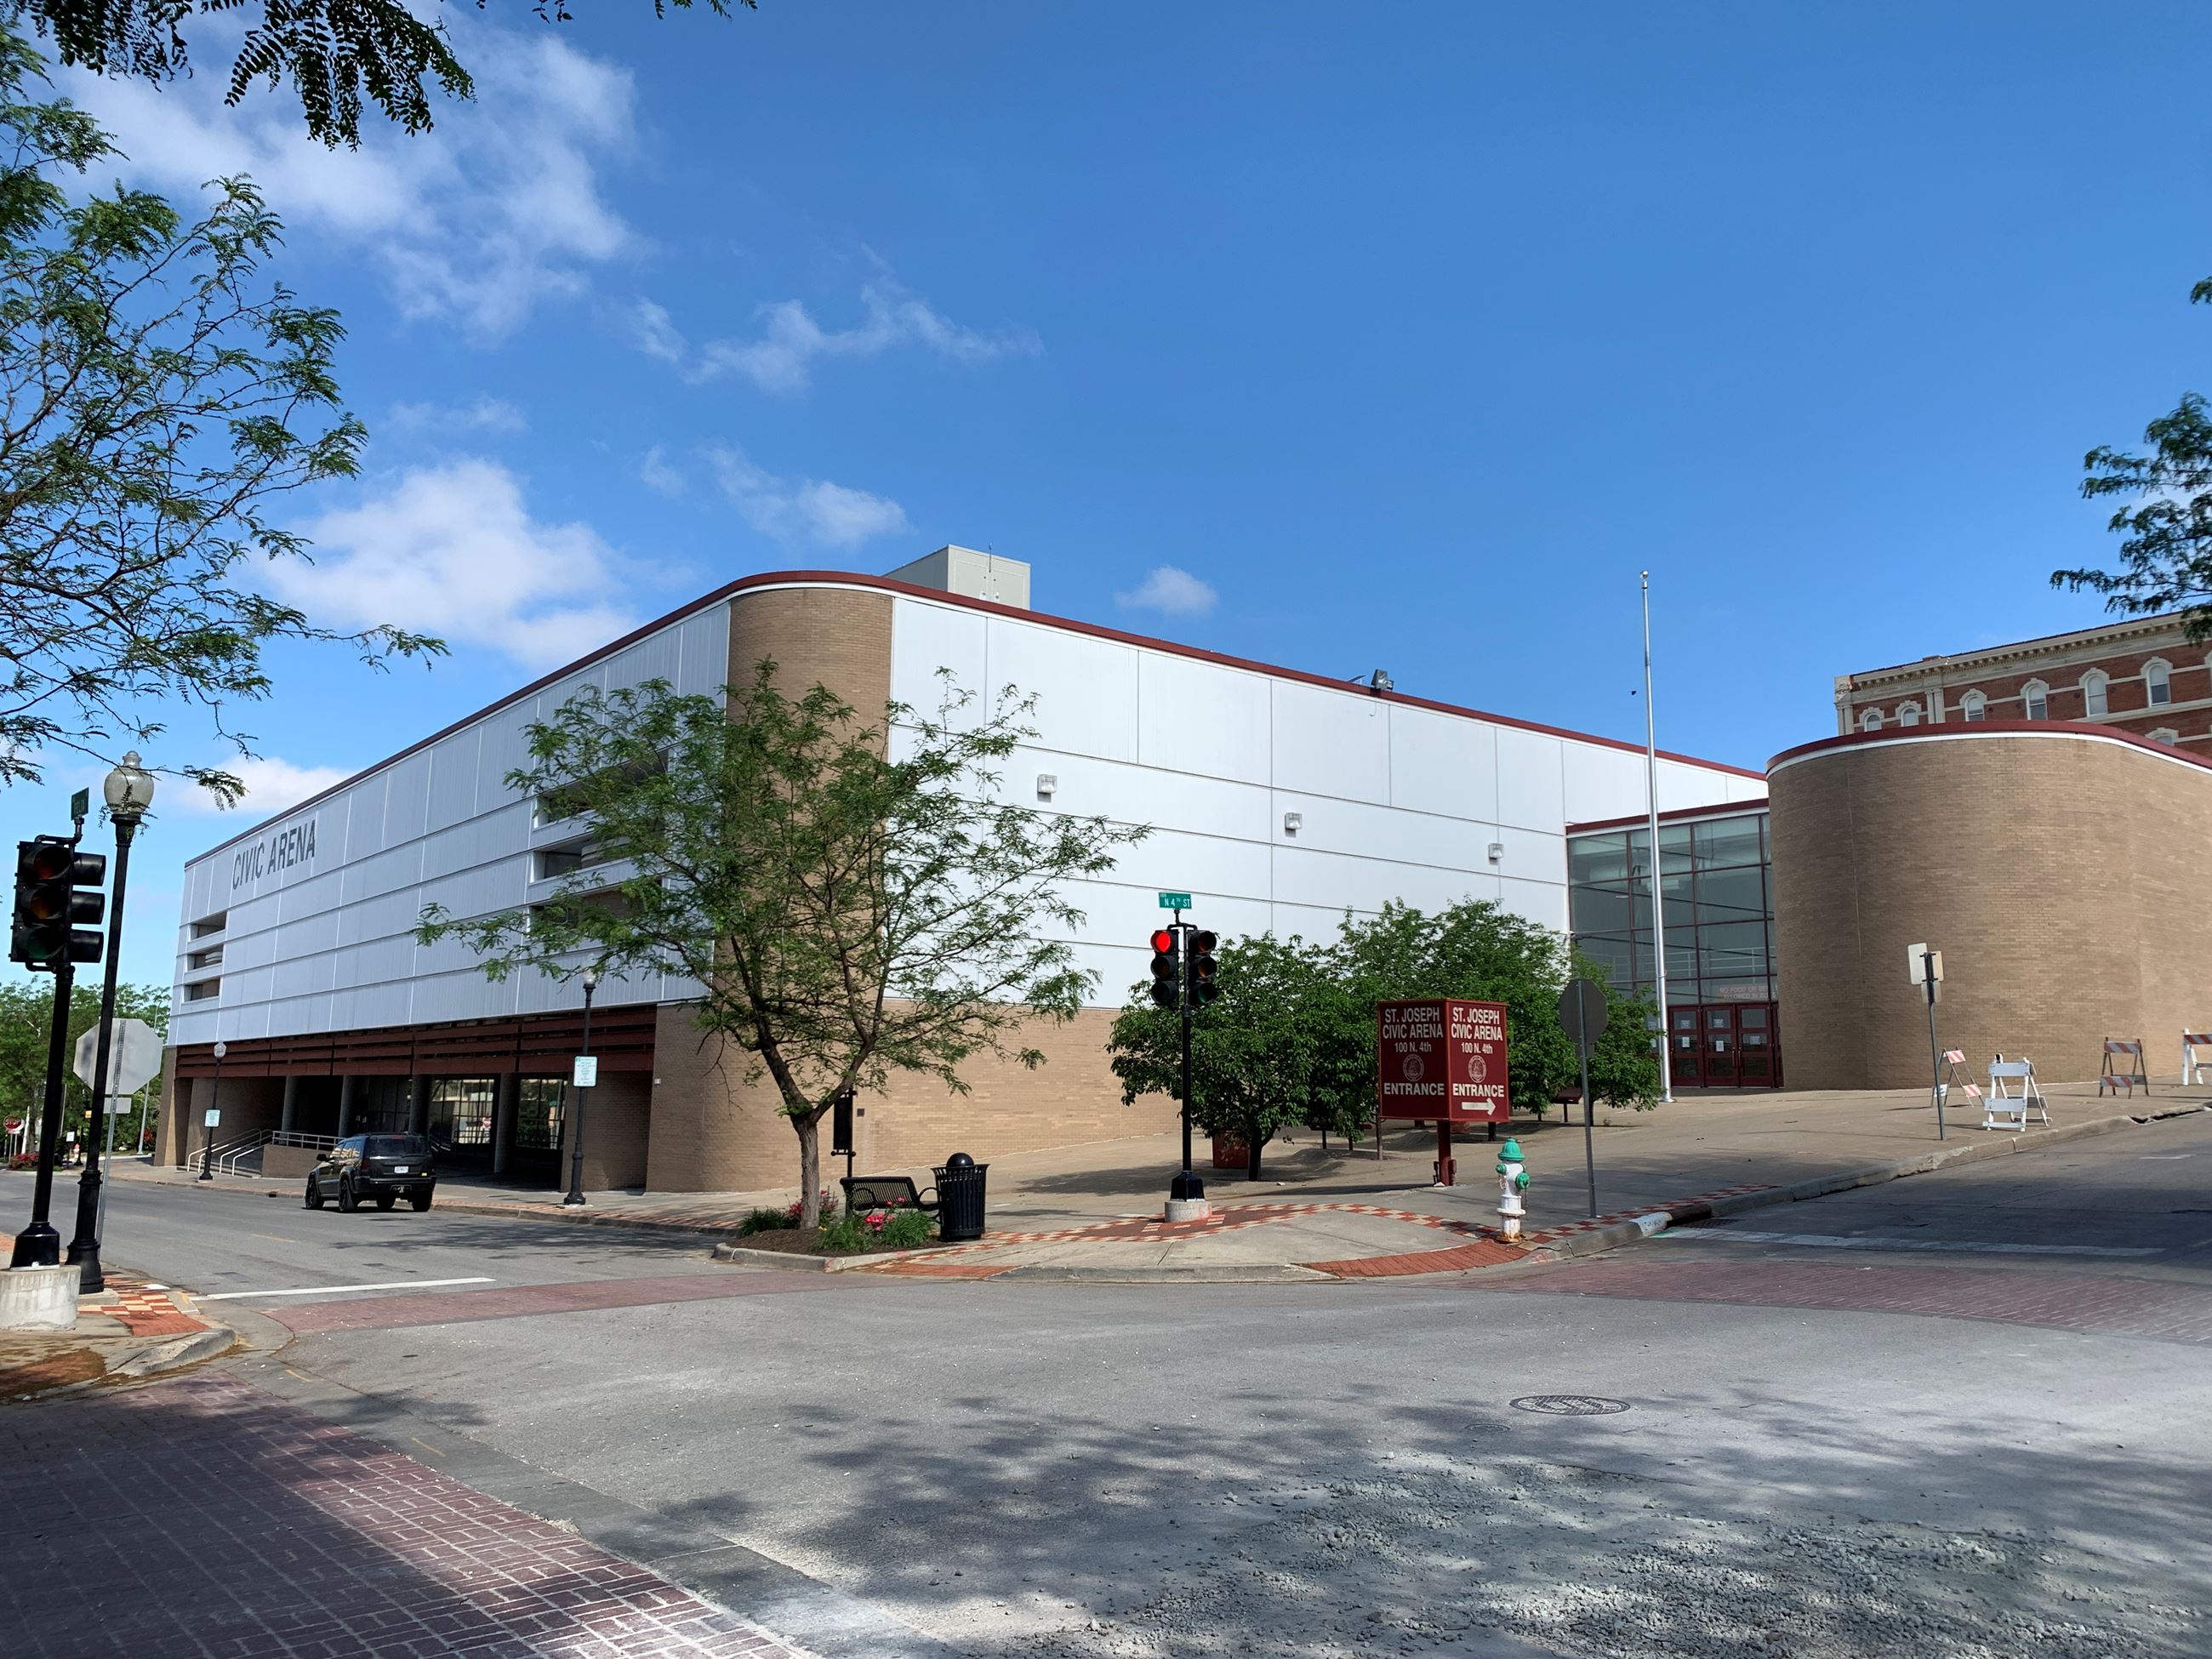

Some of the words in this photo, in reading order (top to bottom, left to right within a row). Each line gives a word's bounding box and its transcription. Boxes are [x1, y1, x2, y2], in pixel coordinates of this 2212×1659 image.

[232, 842, 265, 890] CIVIC
[267, 819, 316, 875] ARENA
[1164, 898, 1169, 906] N
[1183, 898, 1190, 907] ST
[1385, 1008, 1400, 1023] ST.
[1401, 1006, 1440, 1023] JOSEPH
[1452, 1006, 1466, 1023] ST.
[1467, 1008, 1500, 1025] JOSEPH
[1382, 1024, 1407, 1039] CIVIC
[1409, 1023, 1444, 1039] ARENA
[1451, 1023, 1473, 1040] CIVIC
[1474, 1025, 1503, 1041] ARENA
[1394, 1042, 1408, 1052] 100
[1409, 1042, 1417, 1052] N.
[1419, 1041, 1432, 1052] 4th
[1461, 1042, 1473, 1053] 100
[1474, 1042, 1481, 1053] N.
[1482, 1043, 1493, 1054] 4th
[1384, 1083, 1445, 1096] ENTRANCE
[1452, 1083, 1504, 1097] ENTRANCE
